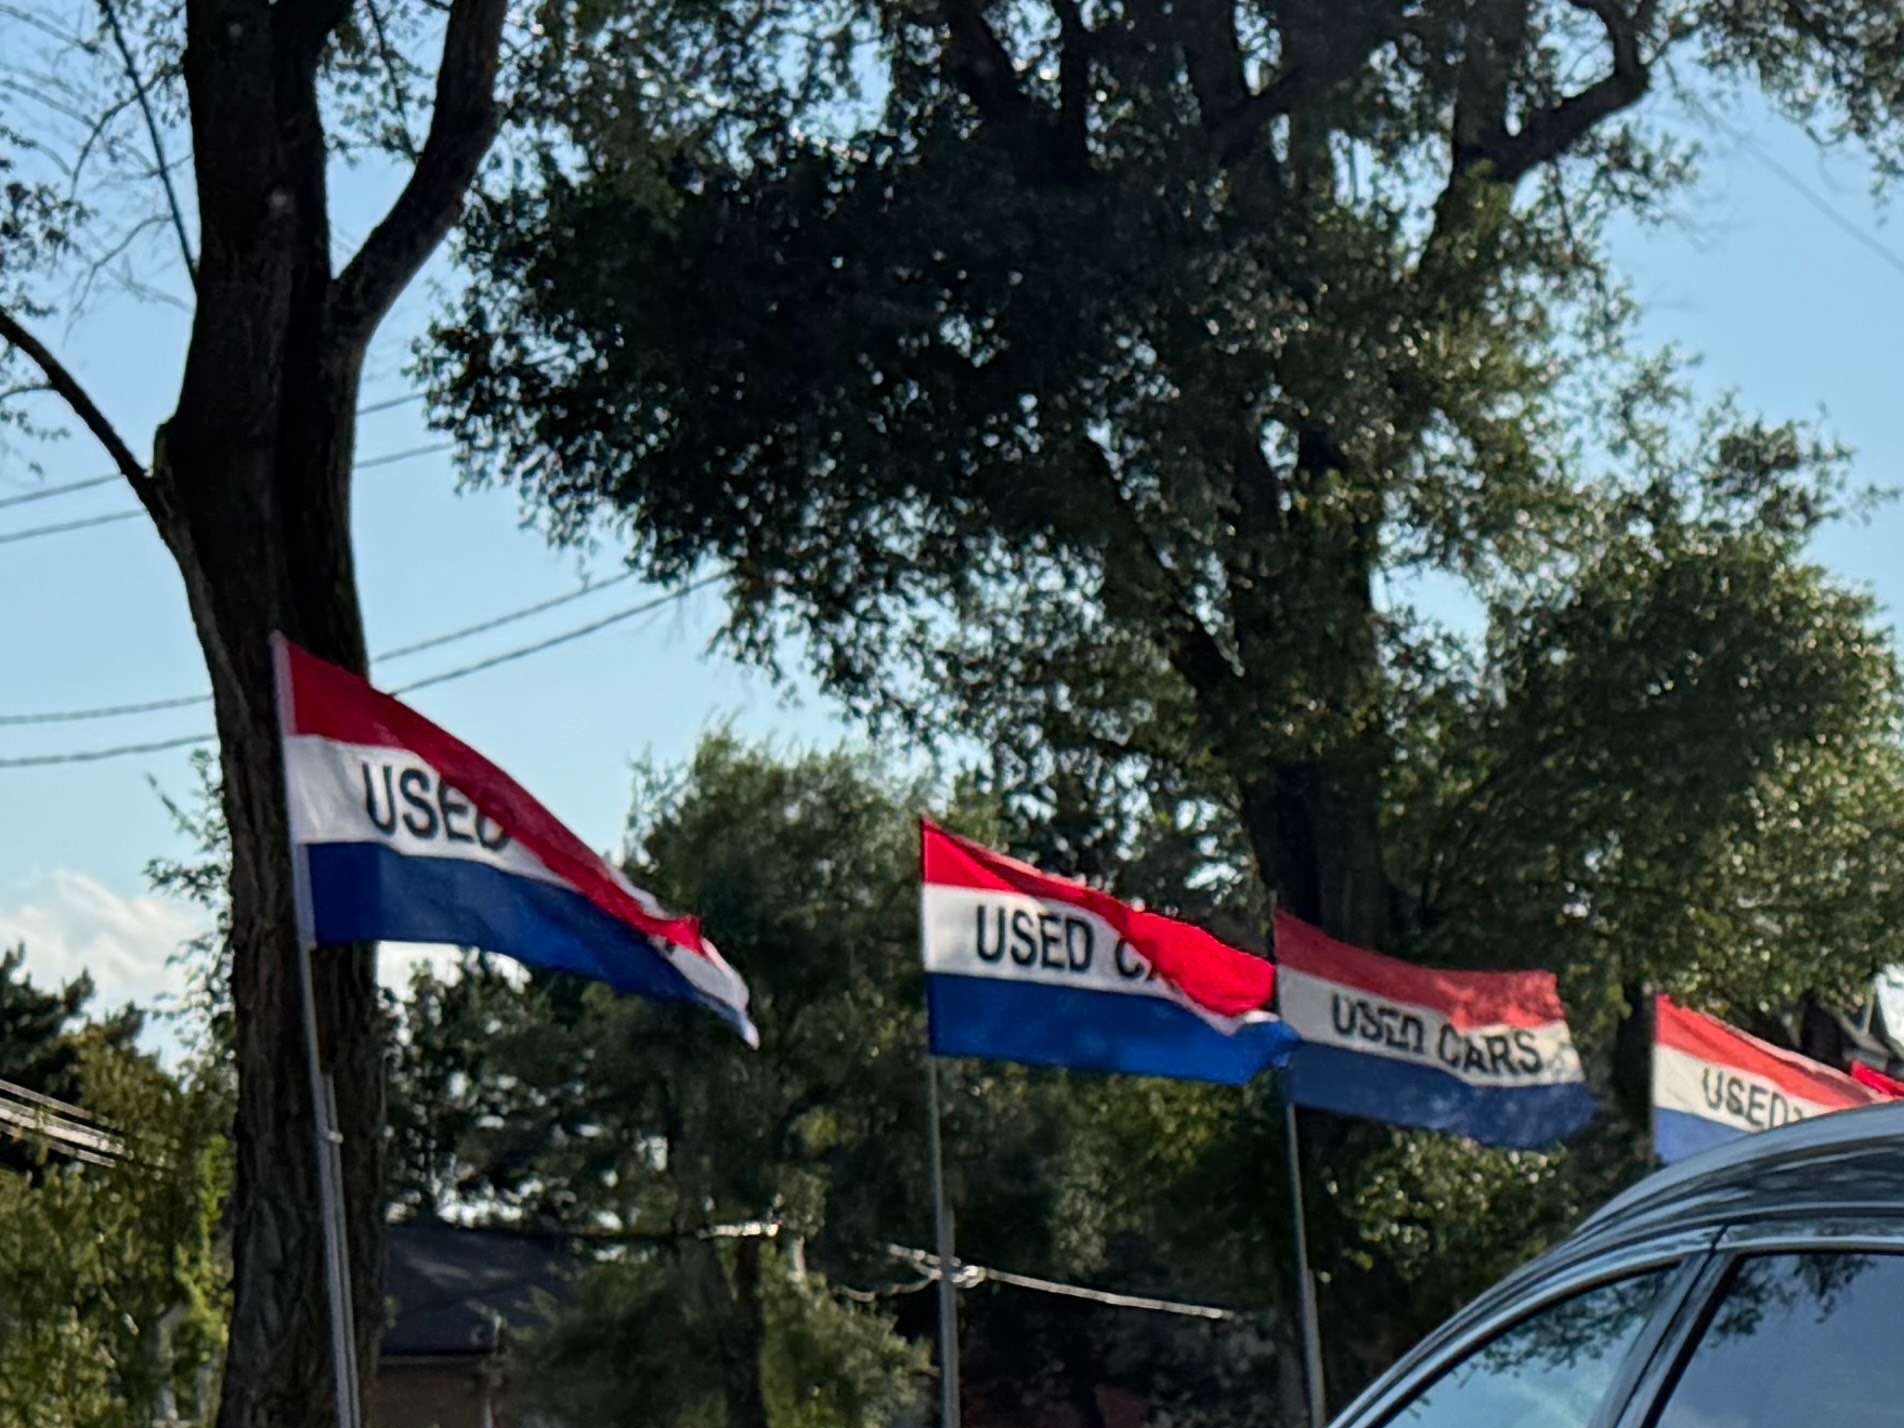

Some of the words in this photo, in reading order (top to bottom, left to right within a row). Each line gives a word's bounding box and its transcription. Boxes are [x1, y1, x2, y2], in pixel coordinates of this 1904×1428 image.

[976, 904, 1095, 974] USED
[1332, 993, 1424, 1053] USED
[1438, 1023, 1543, 1075] CARS
[1702, 1067, 1788, 1128] USED
